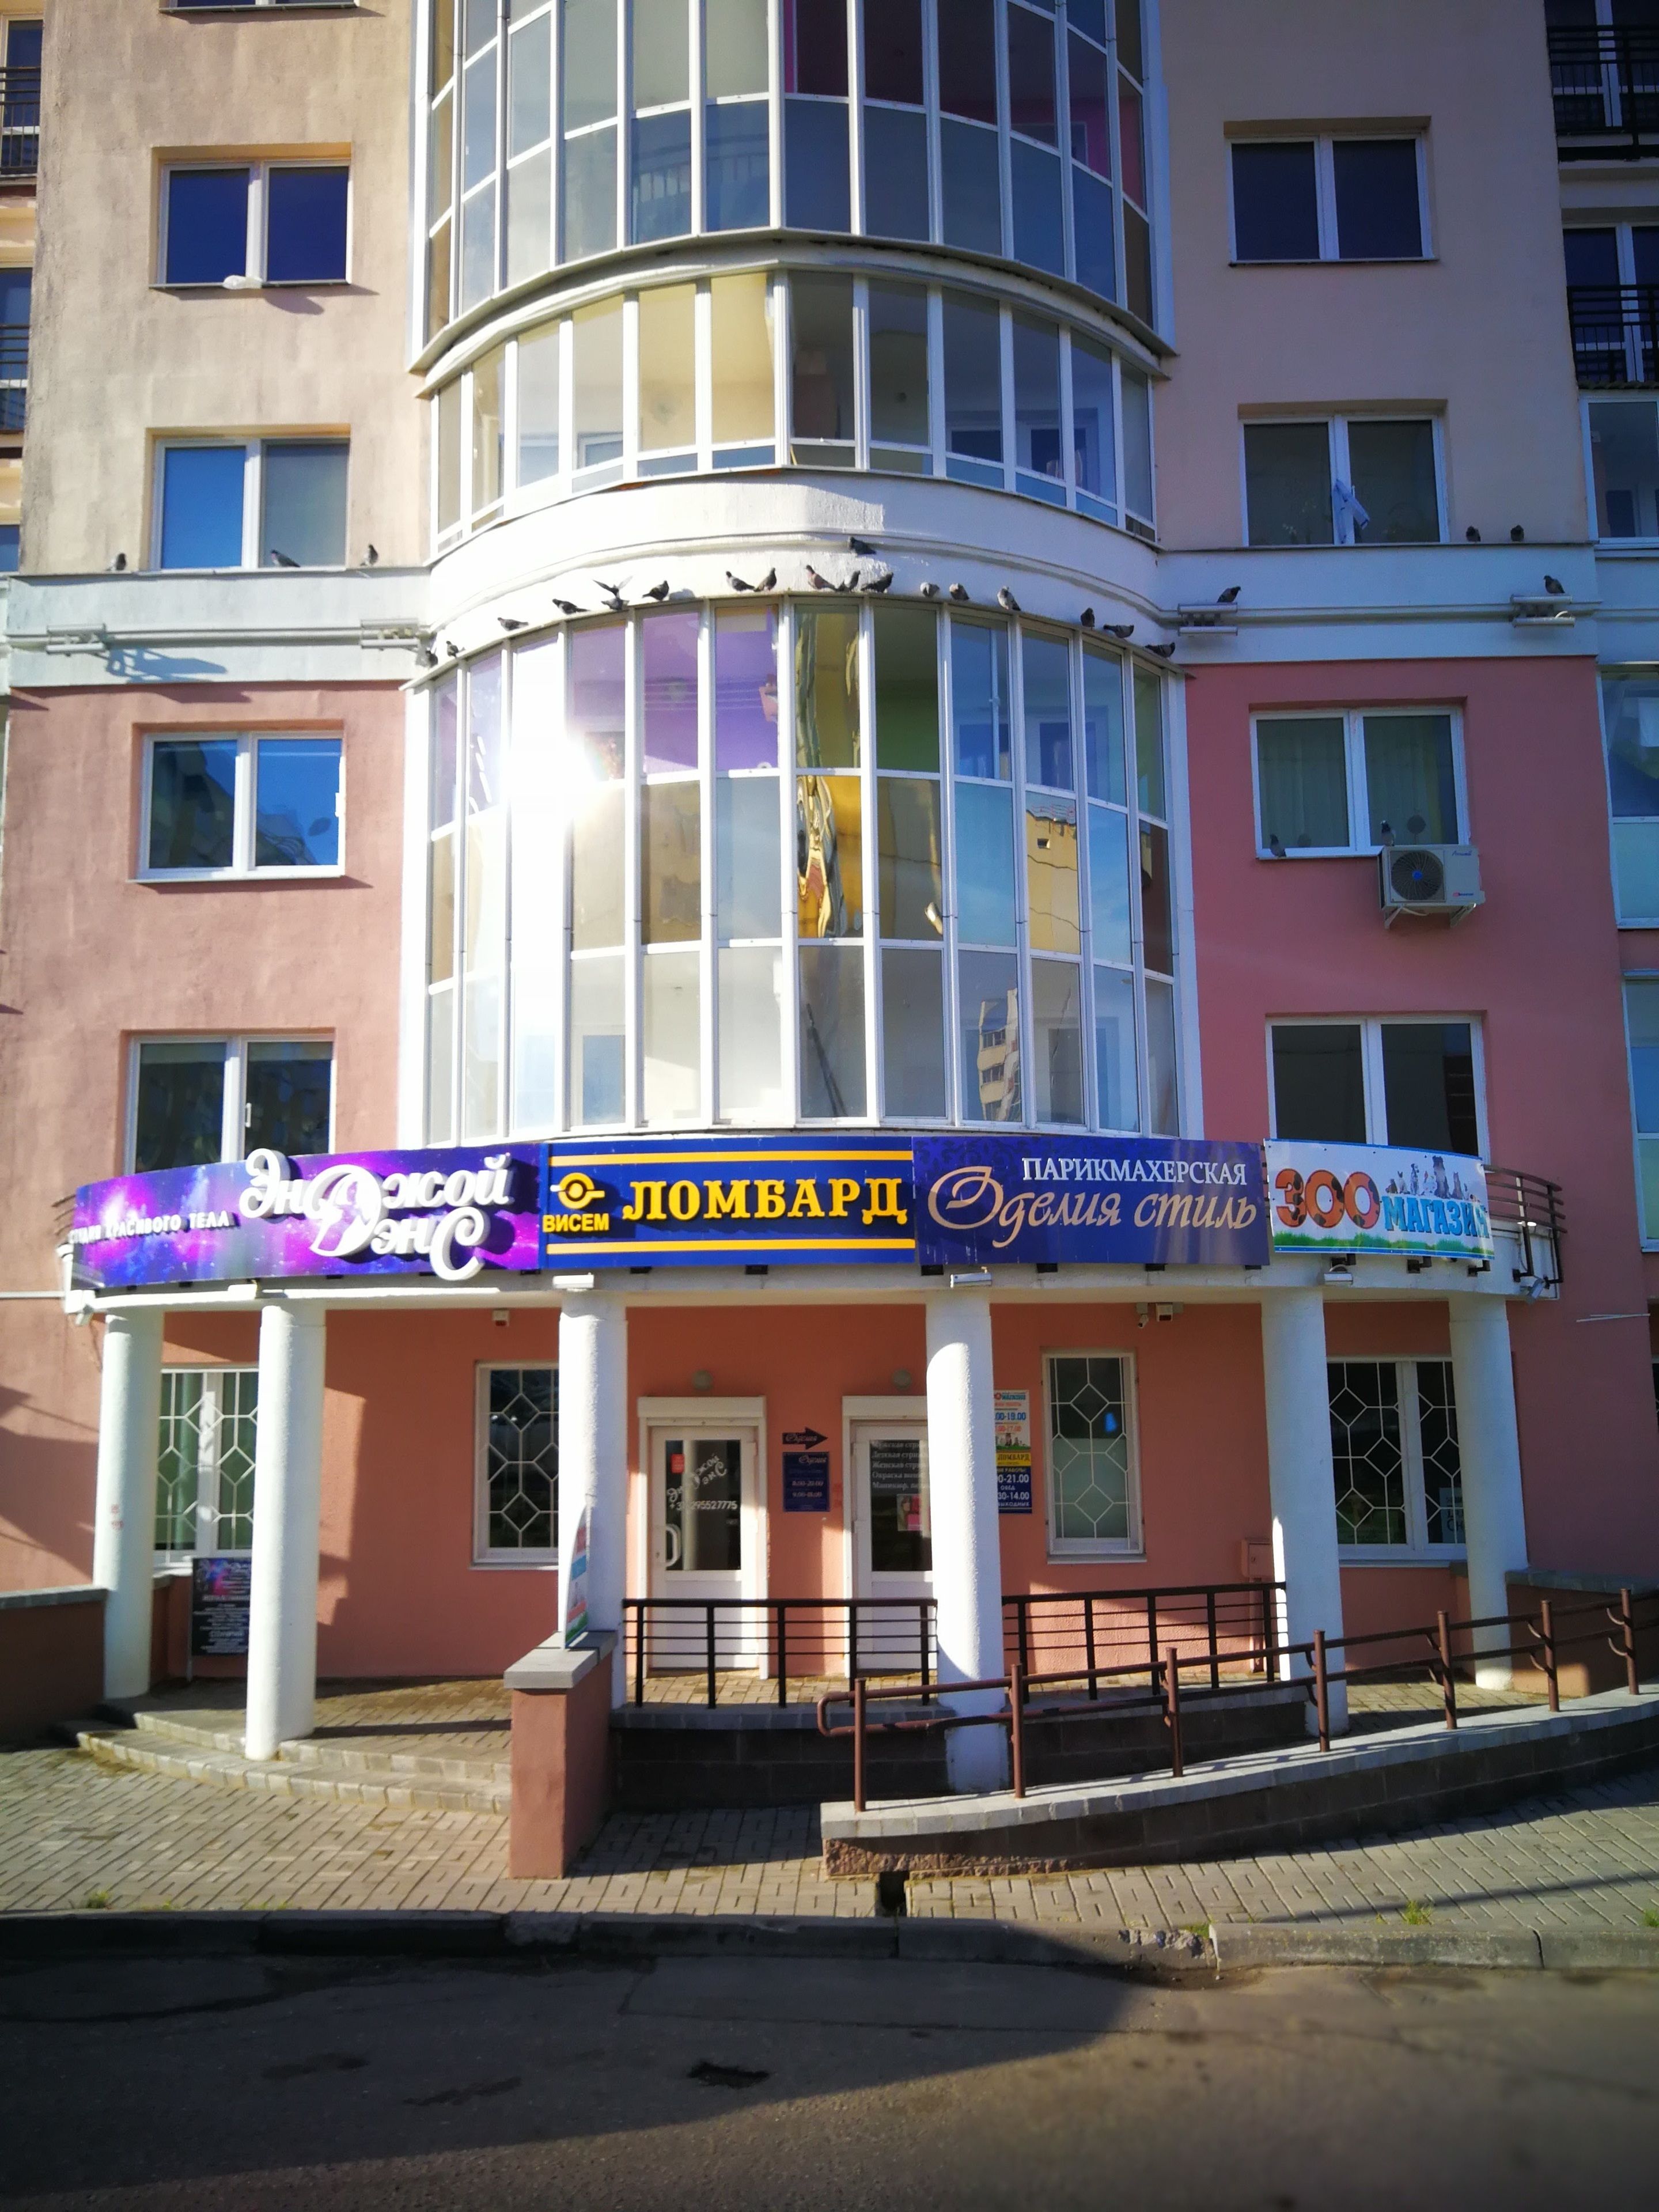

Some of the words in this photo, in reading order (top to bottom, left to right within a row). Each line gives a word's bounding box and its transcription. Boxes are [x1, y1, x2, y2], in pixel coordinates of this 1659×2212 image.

[1022, 1157, 1247, 1185] ПАРИКМАХЕРСКАЯ
[622, 1178, 907, 1225] ЛОМБАРД
[1134, 1192, 1256, 1229] стиль
[1275, 1168, 1381, 1229] ЗОО
[105, 1214, 181, 1239] КРАСИВОГО
[189, 1210, 230, 1229] ТЕЛА
[543, 1213, 609, 1233] ВИСЕМ
[1382, 1196, 1490, 1238] МАГАЗИН
[997, 1453, 1030, 1461] ЛОМБАРД
[998, 1474, 1029, 1483] 0-21.00
[998, 1492, 1029, 1500] 30-14.00
